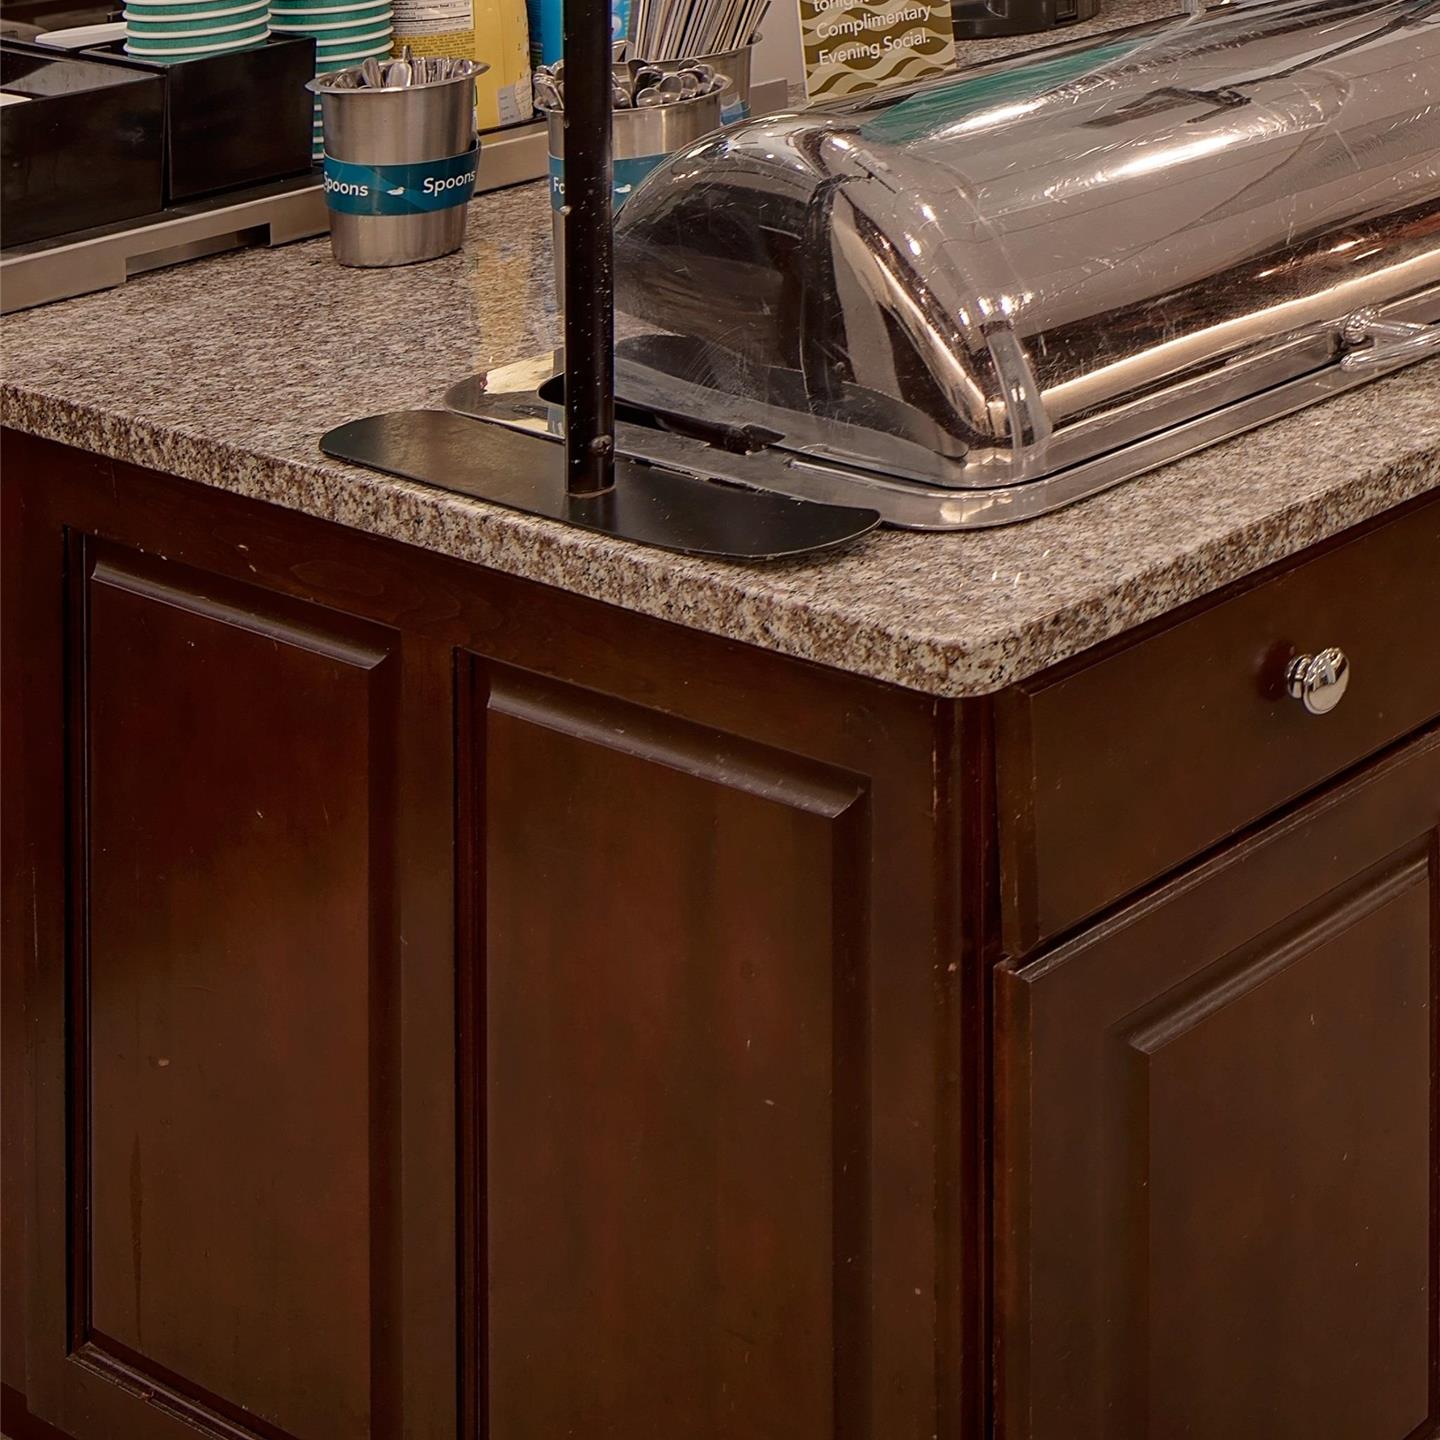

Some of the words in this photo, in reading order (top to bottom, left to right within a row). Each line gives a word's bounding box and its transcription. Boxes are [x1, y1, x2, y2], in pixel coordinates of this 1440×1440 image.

[816, 5, 931, 39] Complimentary
[819, 42, 880, 66] Evening
[883, 27, 931, 52] Social.
[422, 170, 476, 197] Spoons
